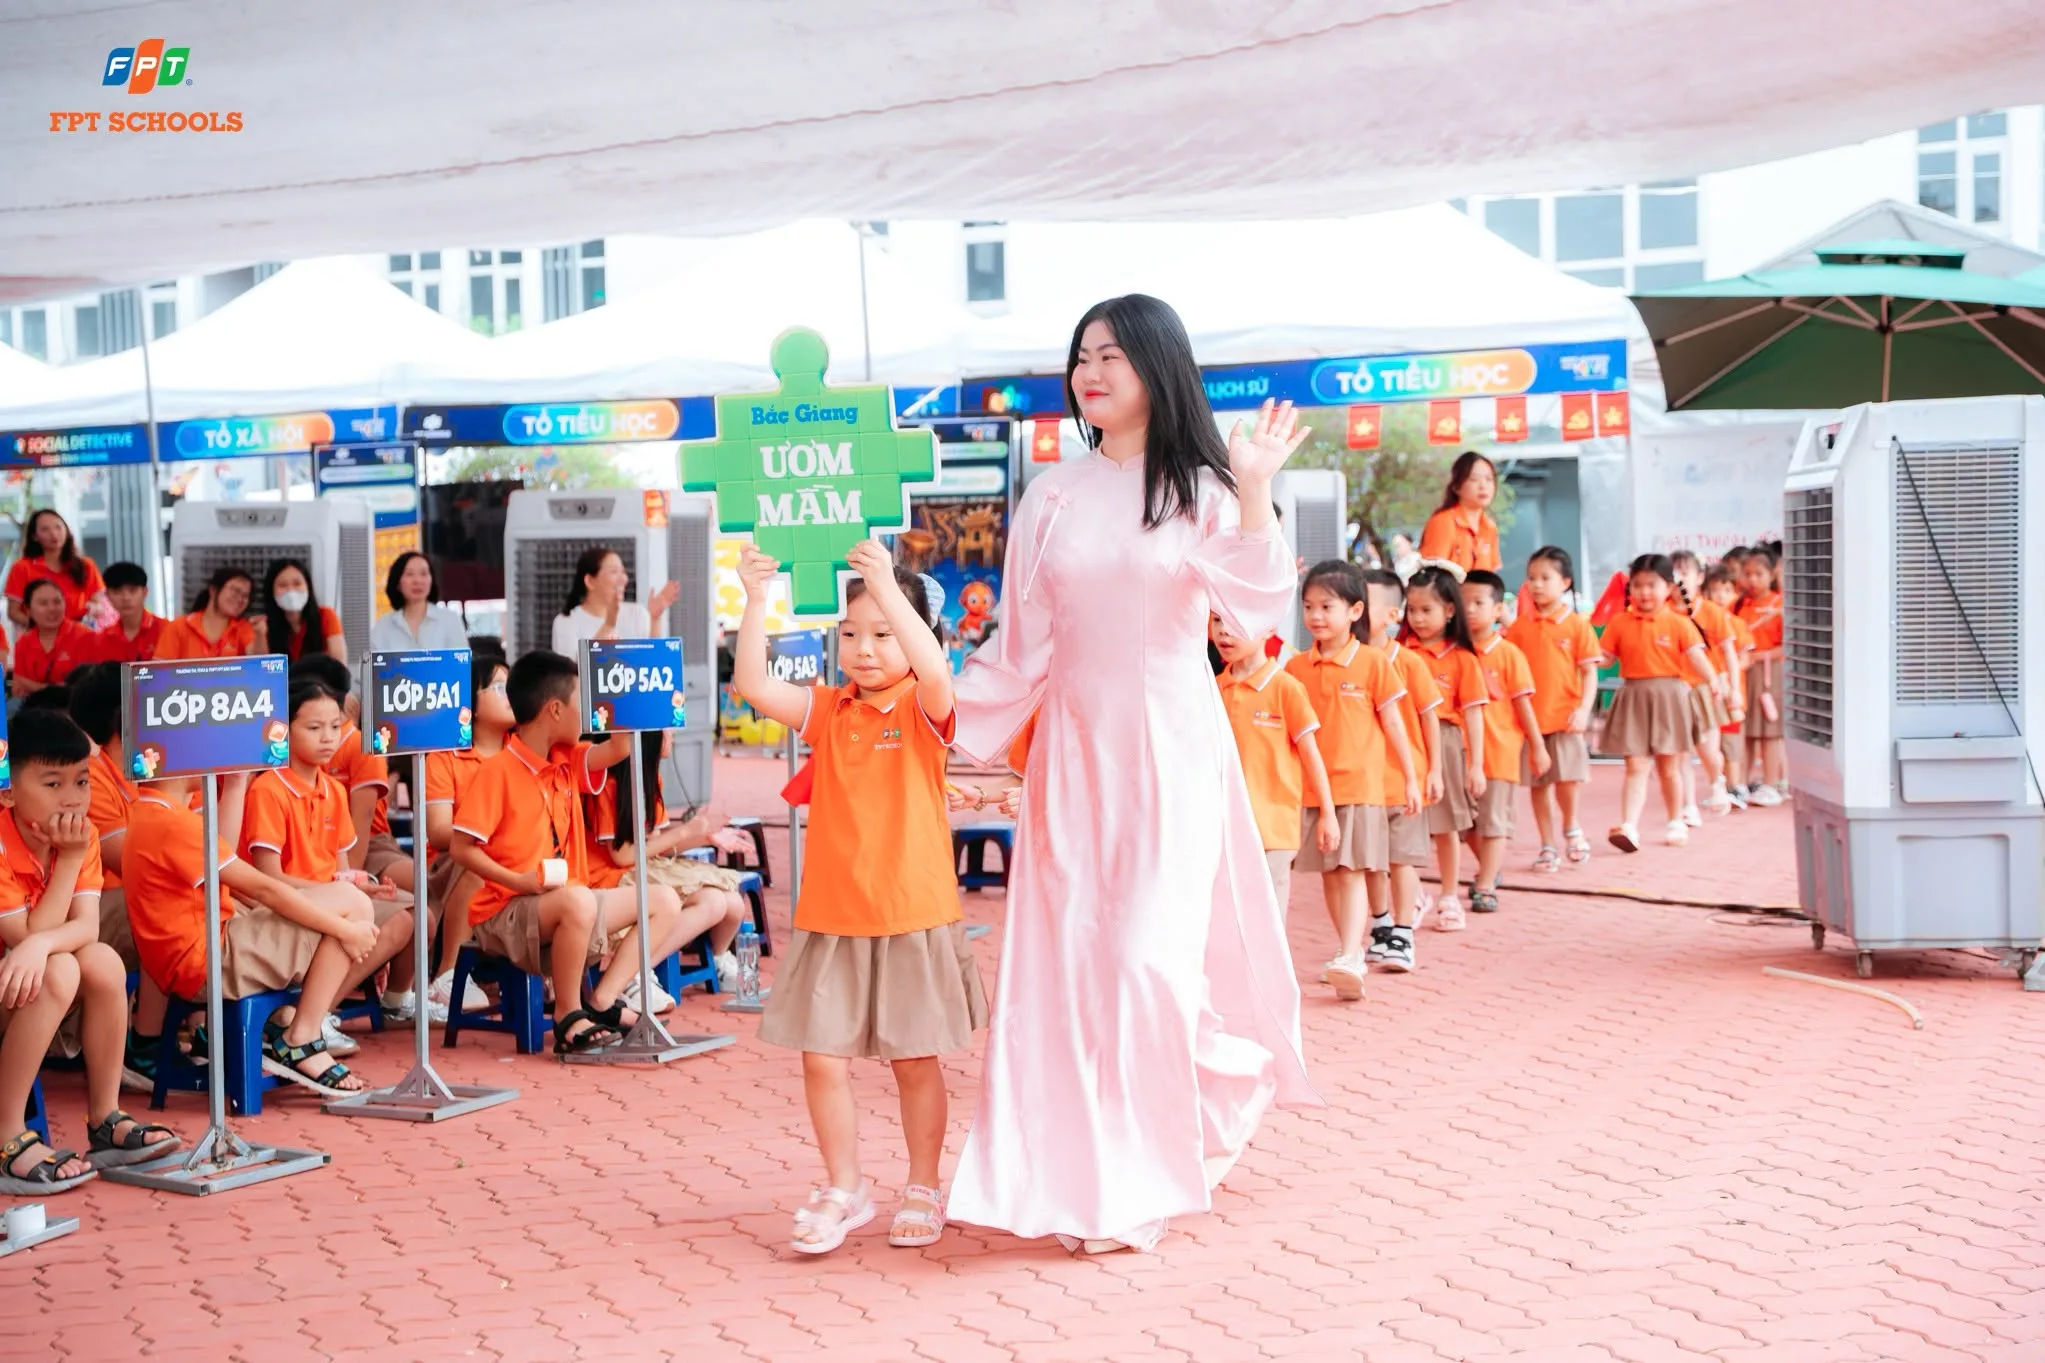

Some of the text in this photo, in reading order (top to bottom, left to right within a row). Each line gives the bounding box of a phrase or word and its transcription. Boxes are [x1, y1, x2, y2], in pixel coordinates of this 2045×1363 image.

[1335, 359, 1509, 395] TỔ TIỂU HỌC
[521, 404, 657, 438] TỔ TIỂU HỌC
[795, 403, 858, 425] Giang
[759, 438, 855, 479] ƯƠM
[598, 662, 674, 694] LỚP 5A2
[794, 654, 818, 681] 5A3
[146, 689, 274, 727] LỚP 8A4
[383, 678, 460, 713] LỚP 5A1
